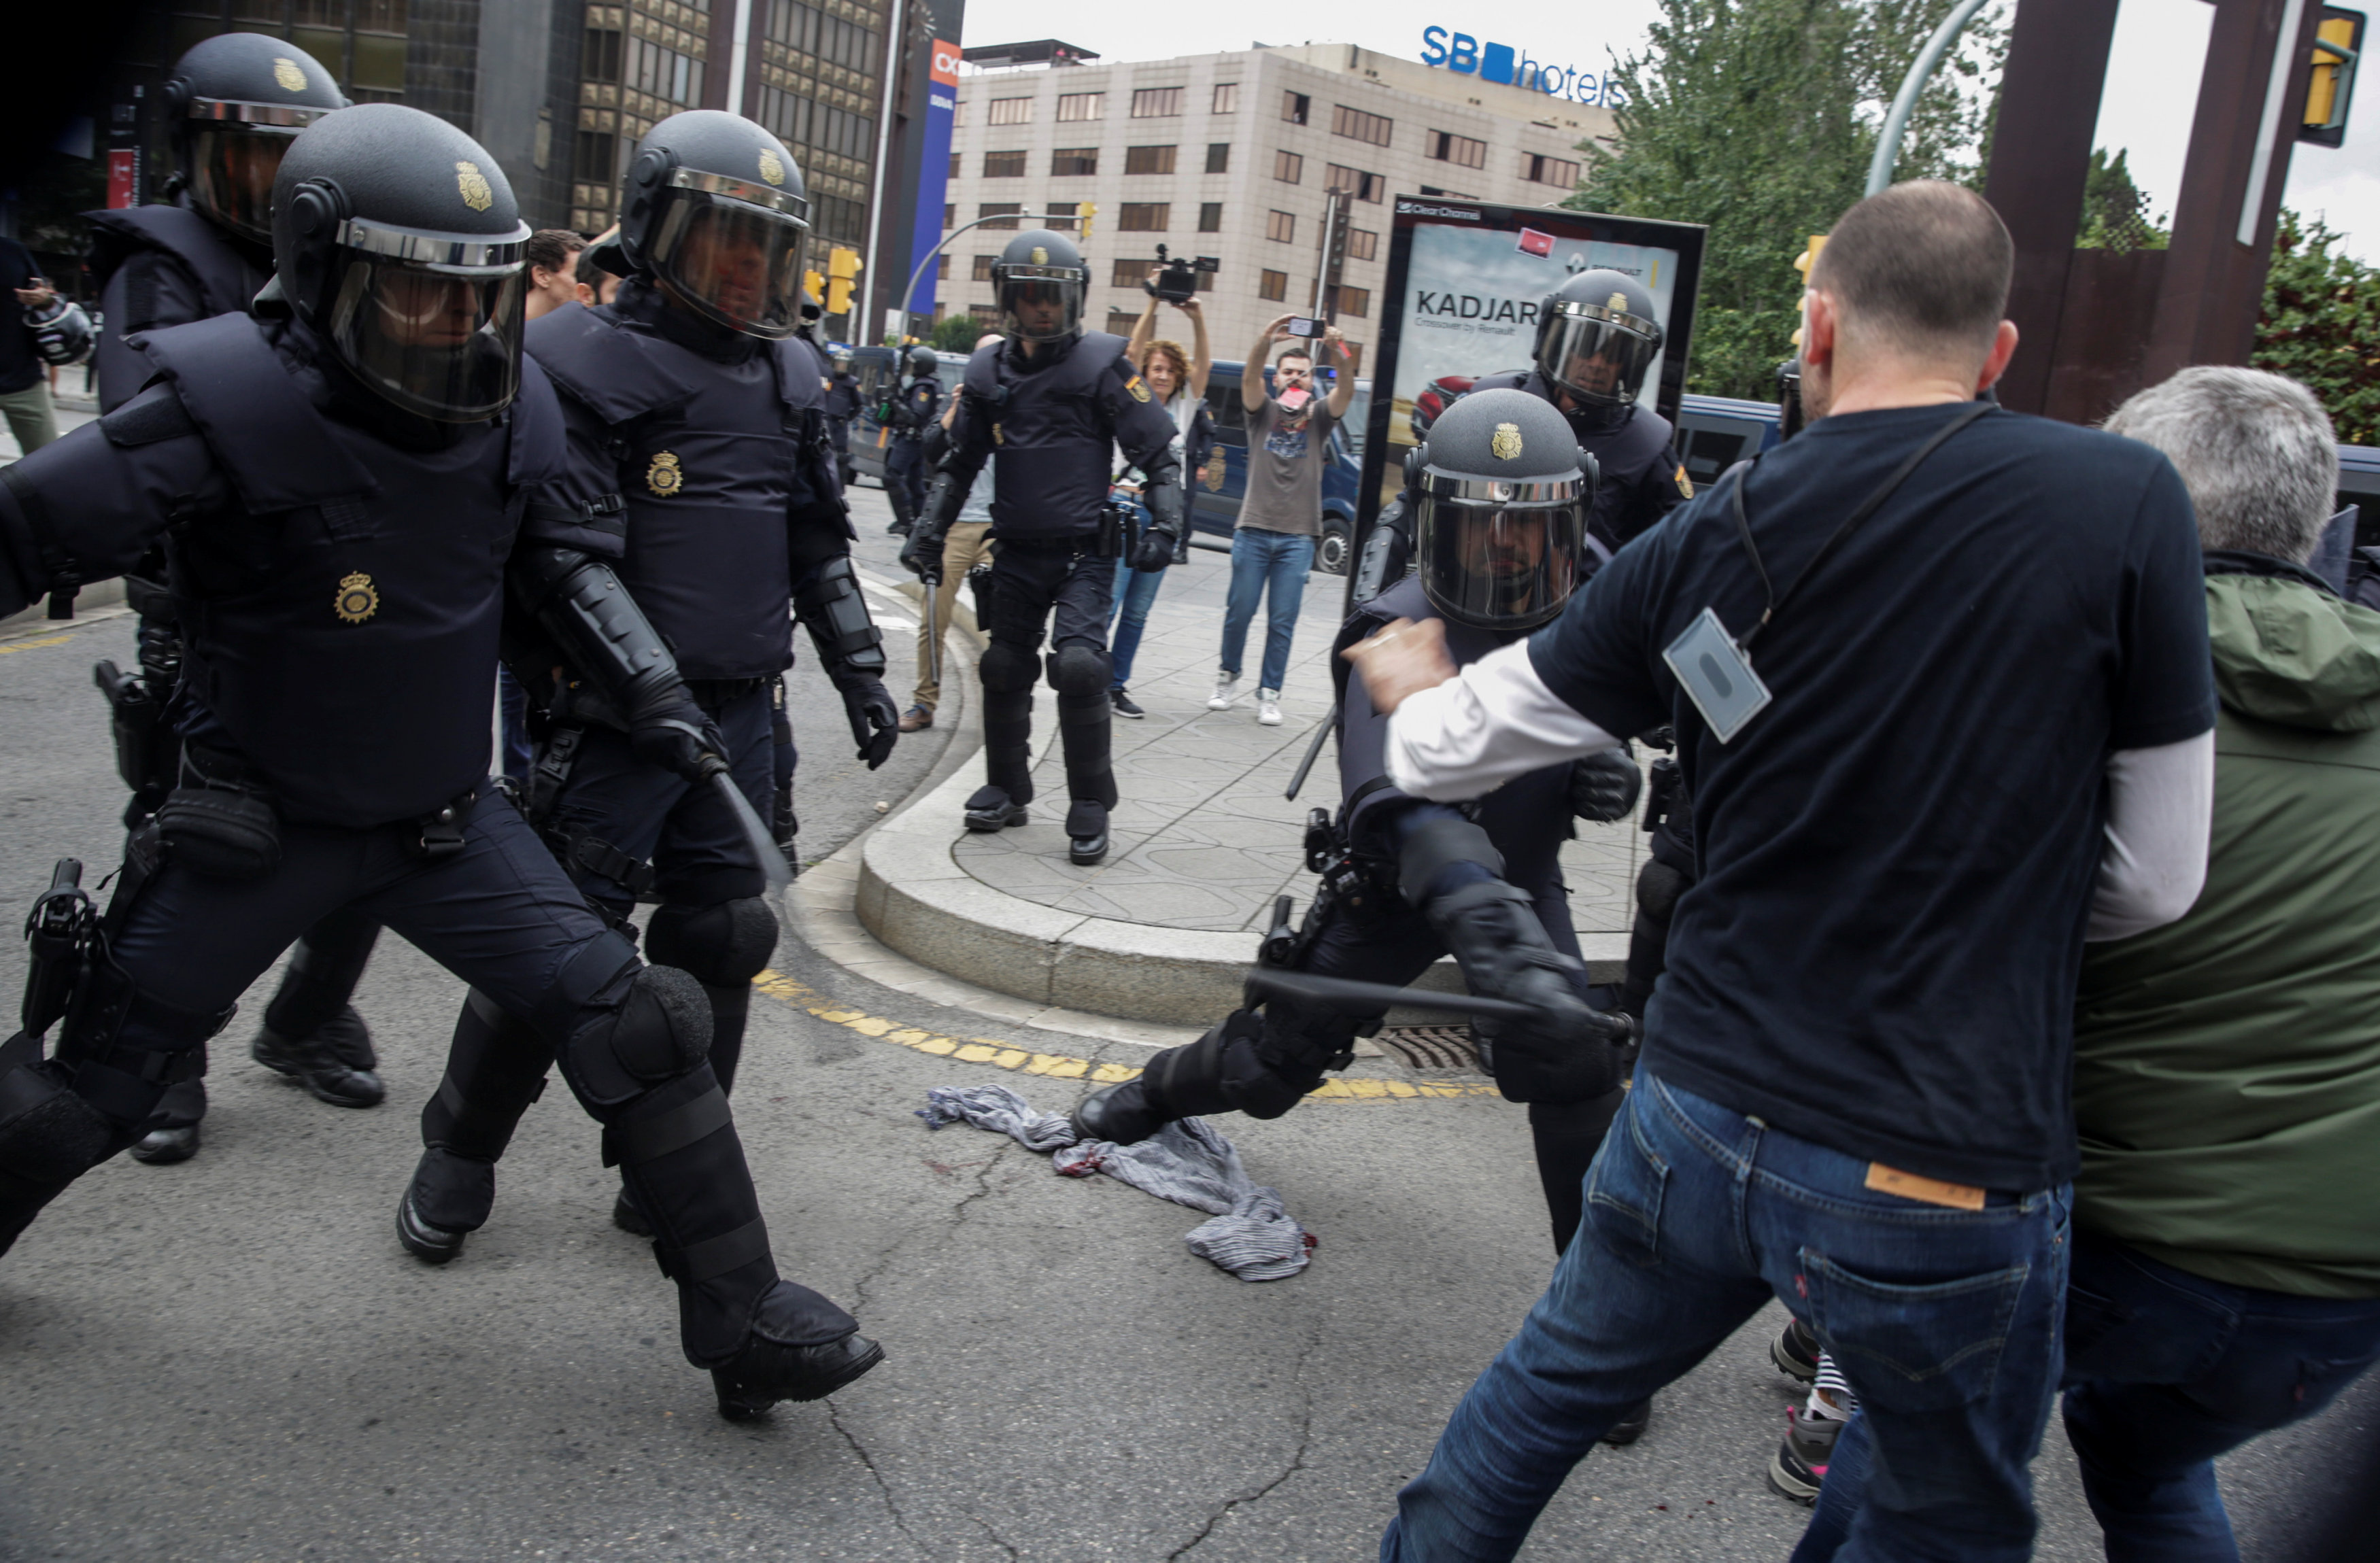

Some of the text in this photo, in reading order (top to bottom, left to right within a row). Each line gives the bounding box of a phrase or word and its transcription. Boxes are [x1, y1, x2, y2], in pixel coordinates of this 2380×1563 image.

[935, 52, 959, 75] CX
[1420, 25, 1625, 109] SB hotels
[1416, 290, 1540, 326] KADJAR
[1414, 317, 1516, 336] Crossover by Renault
